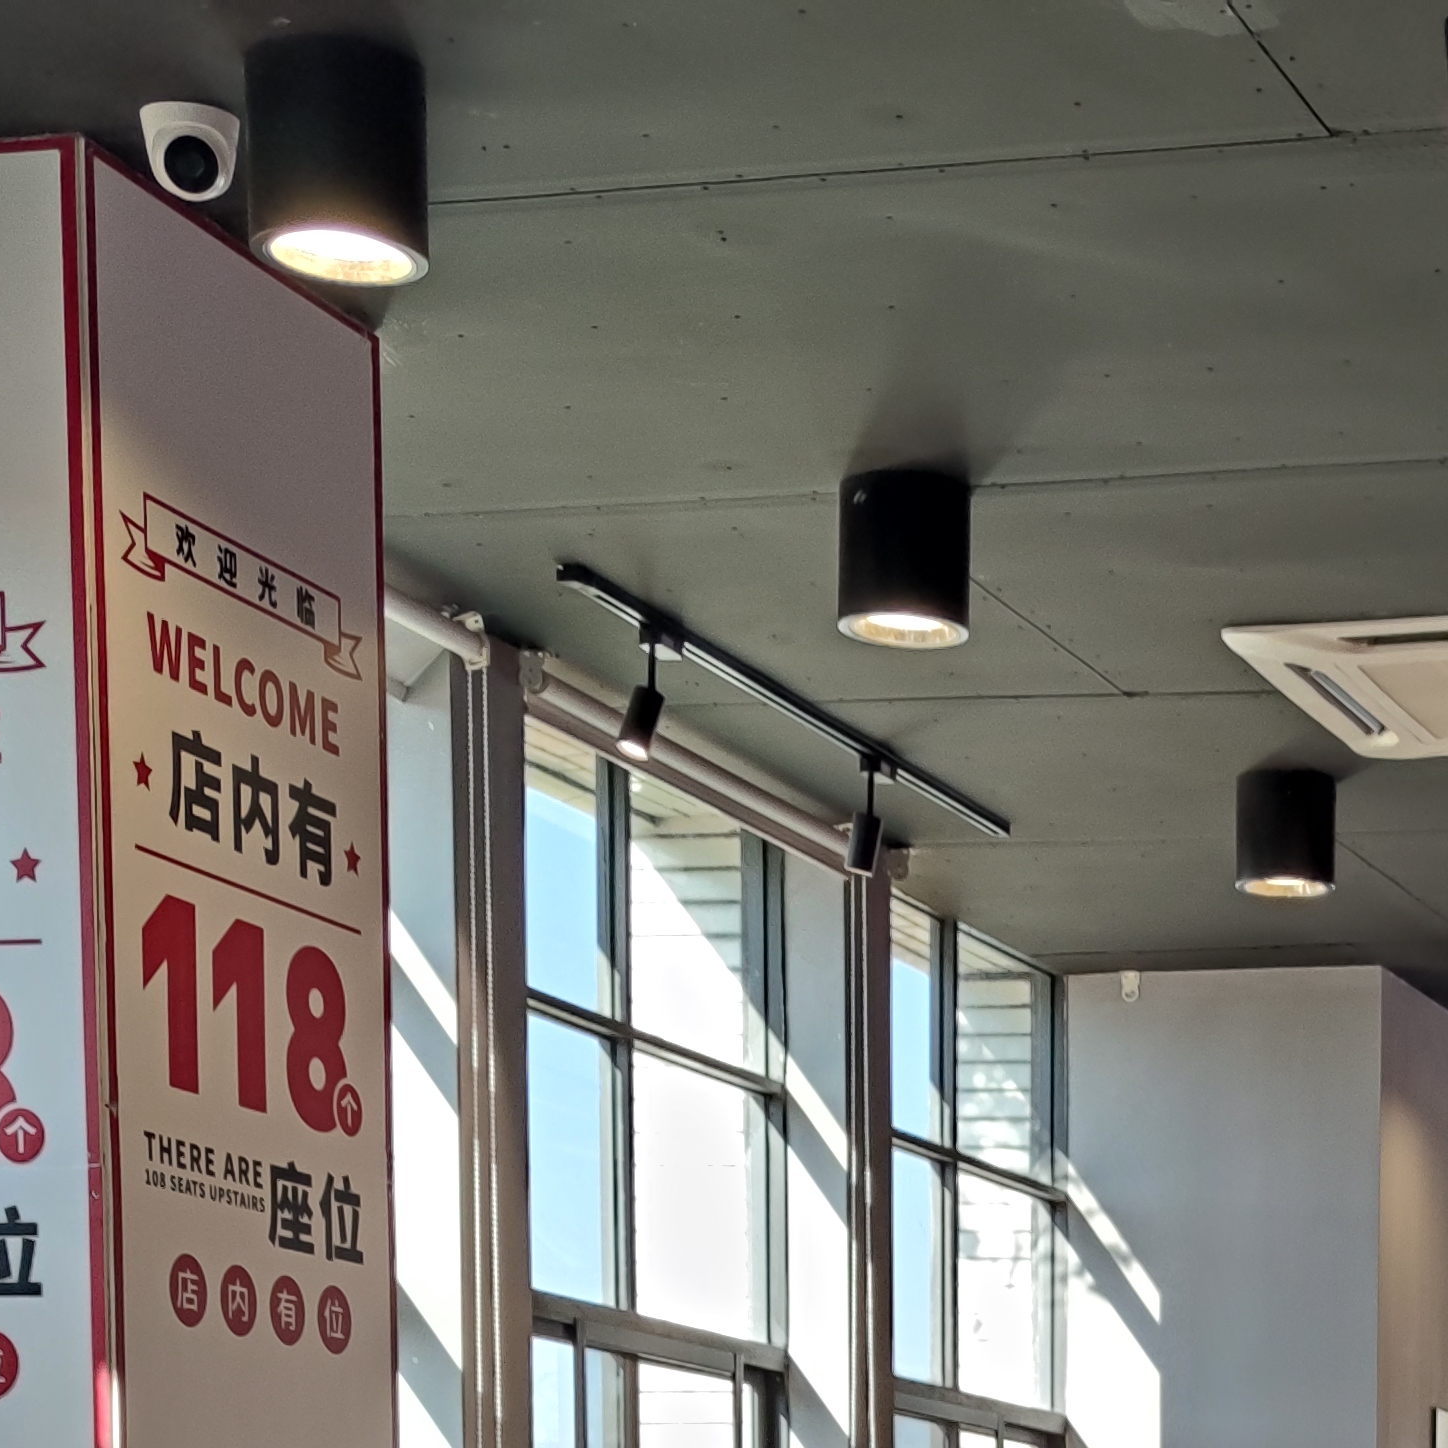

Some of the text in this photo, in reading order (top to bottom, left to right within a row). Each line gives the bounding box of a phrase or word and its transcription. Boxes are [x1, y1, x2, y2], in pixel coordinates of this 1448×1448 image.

[175, 523, 316, 631] 欢迎光临
[146, 611, 340, 757] WELCOME
[169, 730, 337, 886] 店内有
[142, 894, 348, 1133] 118
[143, 1129, 264, 1190] THERE ARE
[145, 1167, 266, 1213] 108 SEATS UPSTAIRS
[268, 1160, 364, 1265] 座位
[176, 1268, 345, 1341] 店内有位
